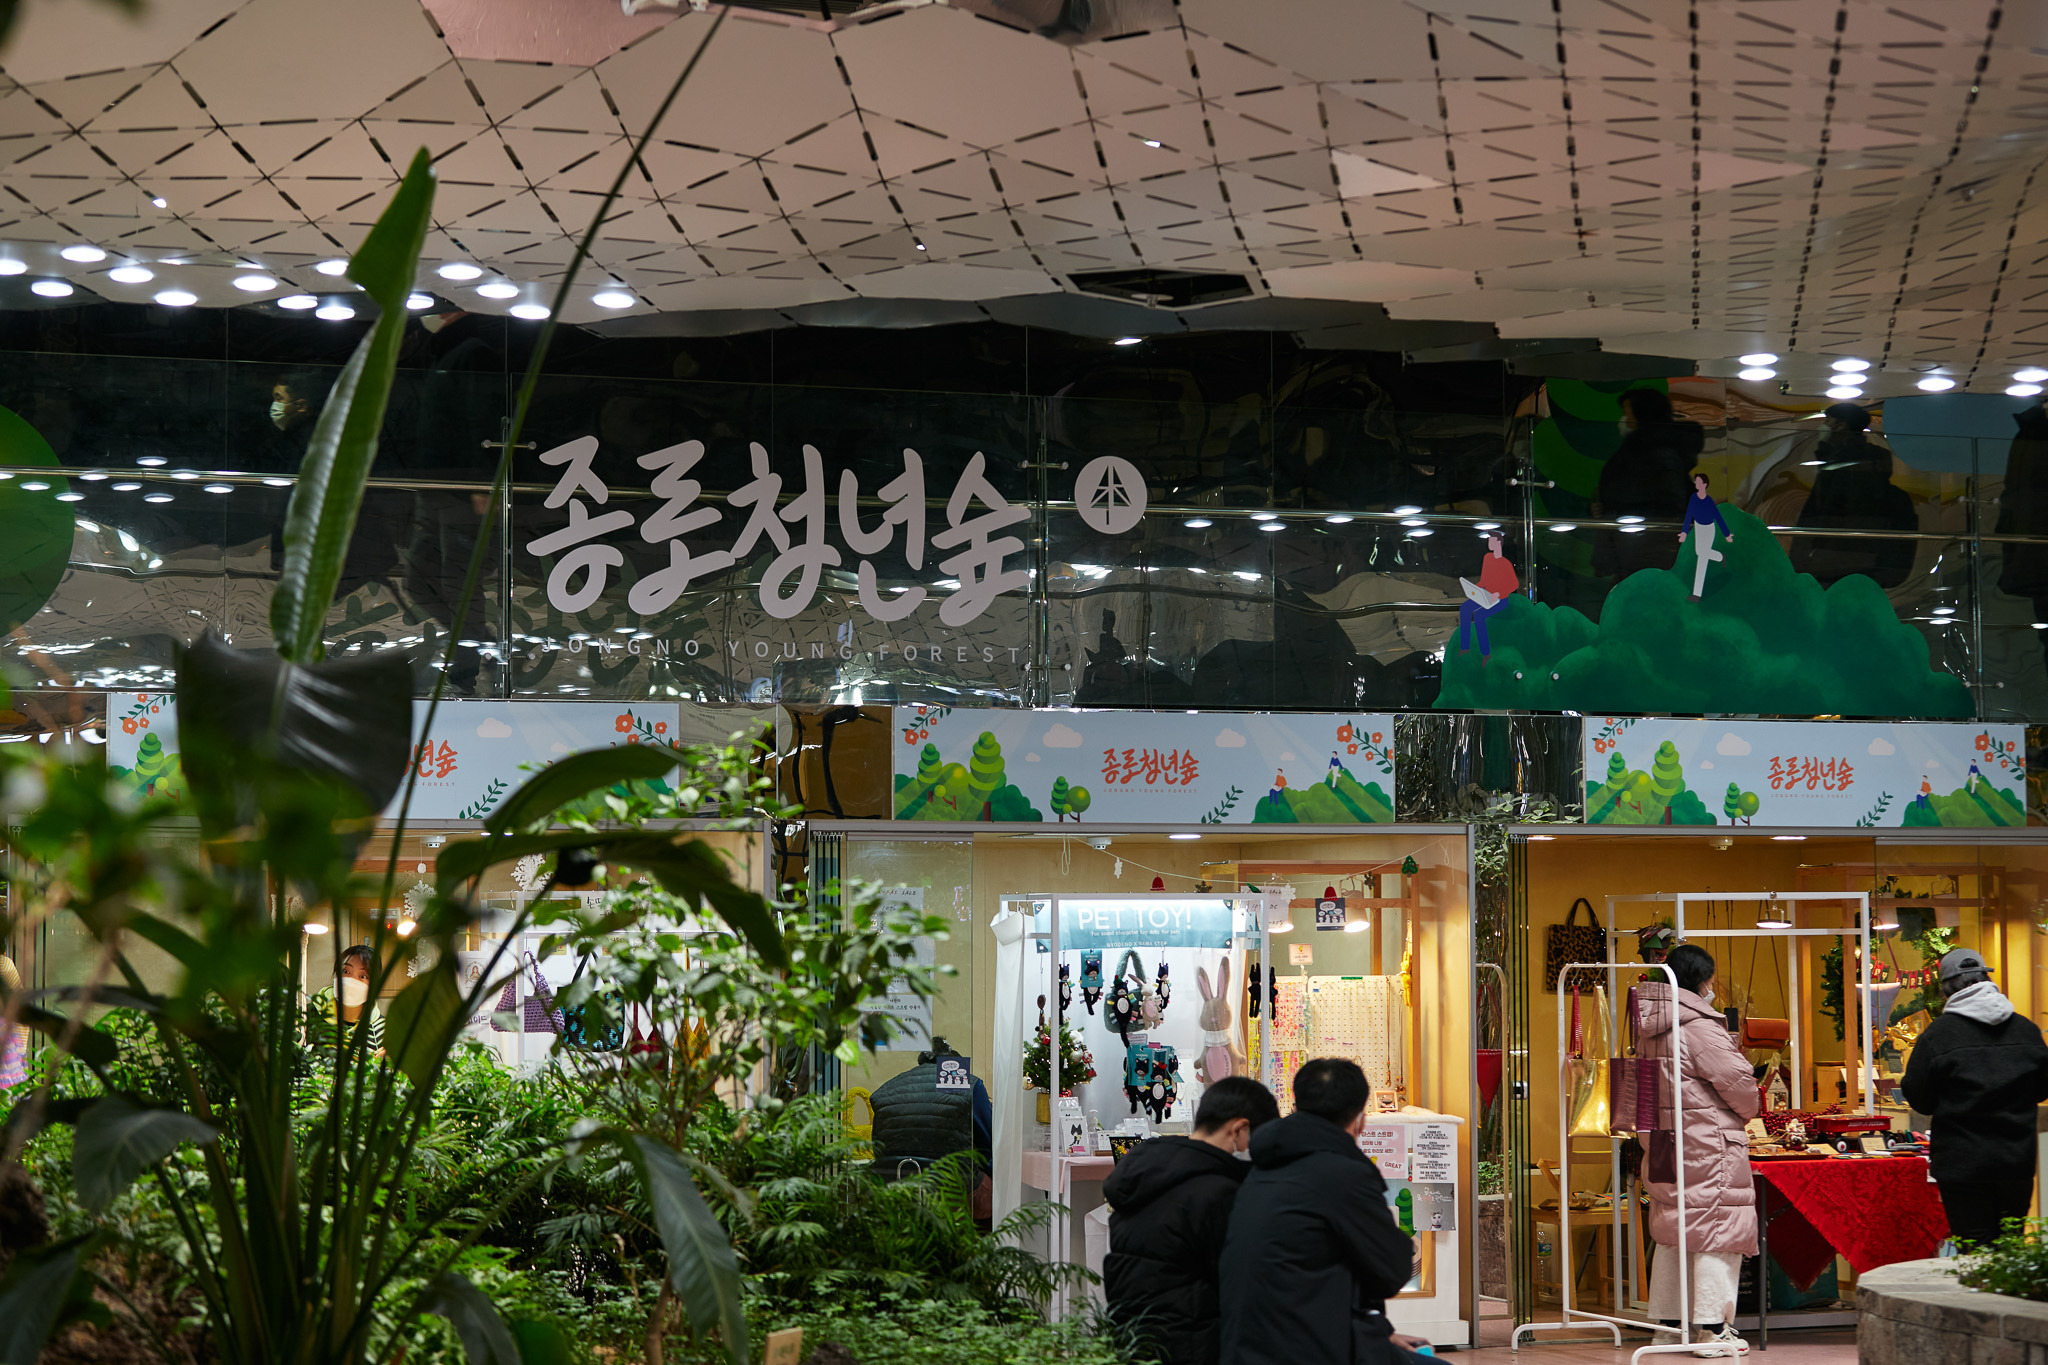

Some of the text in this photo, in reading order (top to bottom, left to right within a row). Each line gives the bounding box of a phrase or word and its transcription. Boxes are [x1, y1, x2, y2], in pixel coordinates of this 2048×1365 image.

[526, 435, 1031, 627] 종로청년숲
[541, 637, 1019, 663] JONGNO YOUNG FOREST
[1101, 748, 1200, 785] 종로청년숲
[1767, 756, 1854, 791] 종로청년숲
[1078, 906, 1192, 930] PET TOY!
[1384, 1161, 1402, 1169] GREAT
